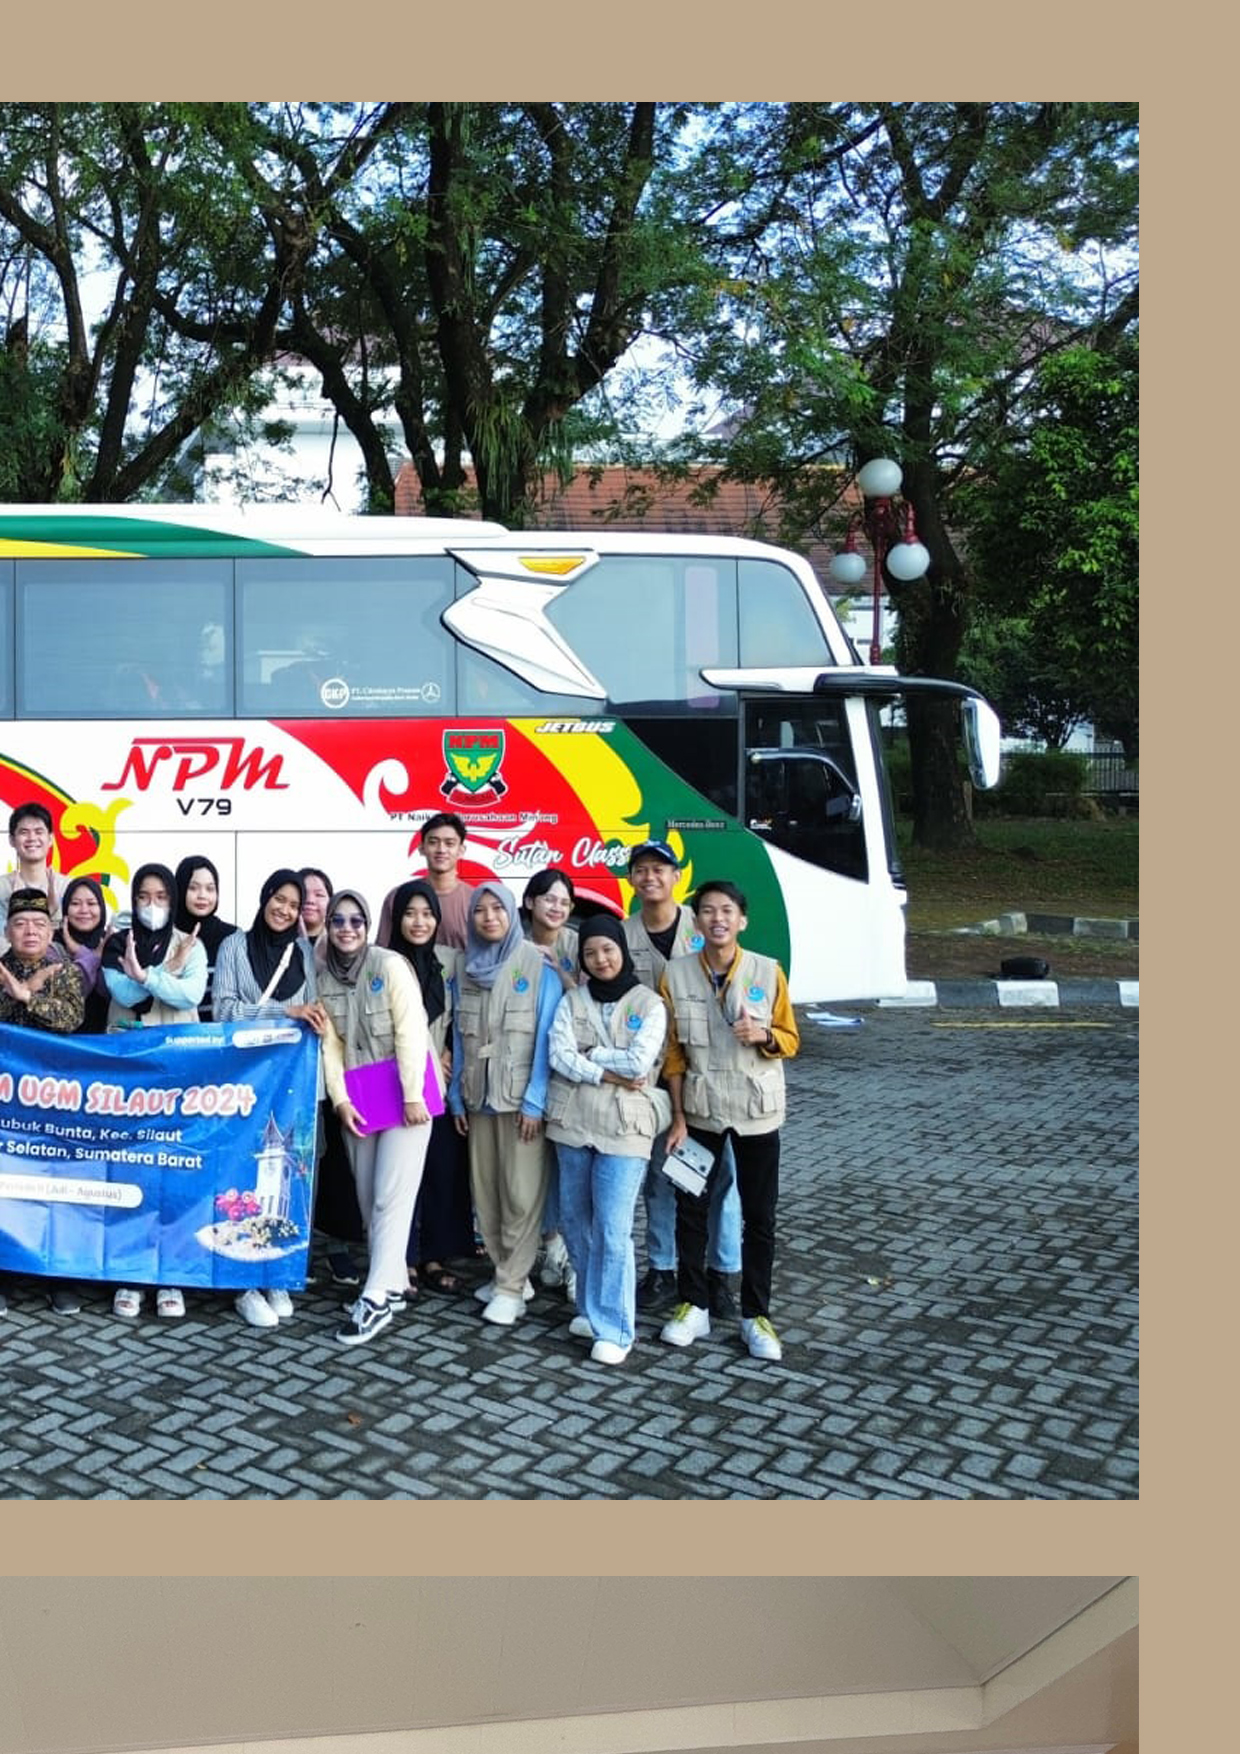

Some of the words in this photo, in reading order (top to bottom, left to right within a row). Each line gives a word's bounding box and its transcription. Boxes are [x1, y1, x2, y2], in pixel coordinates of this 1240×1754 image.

[536, 721, 616, 733] JETBUS
[448, 735, 499, 748] NPM
[101, 737, 290, 791] NPM
[176, 798, 232, 815] V79
[390, 813, 403, 821] PT
[493, 834, 564, 870] Sutan
[571, 837, 630, 868] Class
[18, 1074, 82, 1112] UGM
[85, 1081, 182, 1116] SILAUT
[180, 1083, 257, 1117] 2024
[45, 1122, 96, 1142] Bunta,
[100, 1127, 134, 1141] Kec.
[136, 1127, 182, 1143] Silaut
[6, 1140, 73, 1160] Selatan,
[75, 1147, 155, 1166] Sumatera
[158, 1152, 203, 1169] Barat
